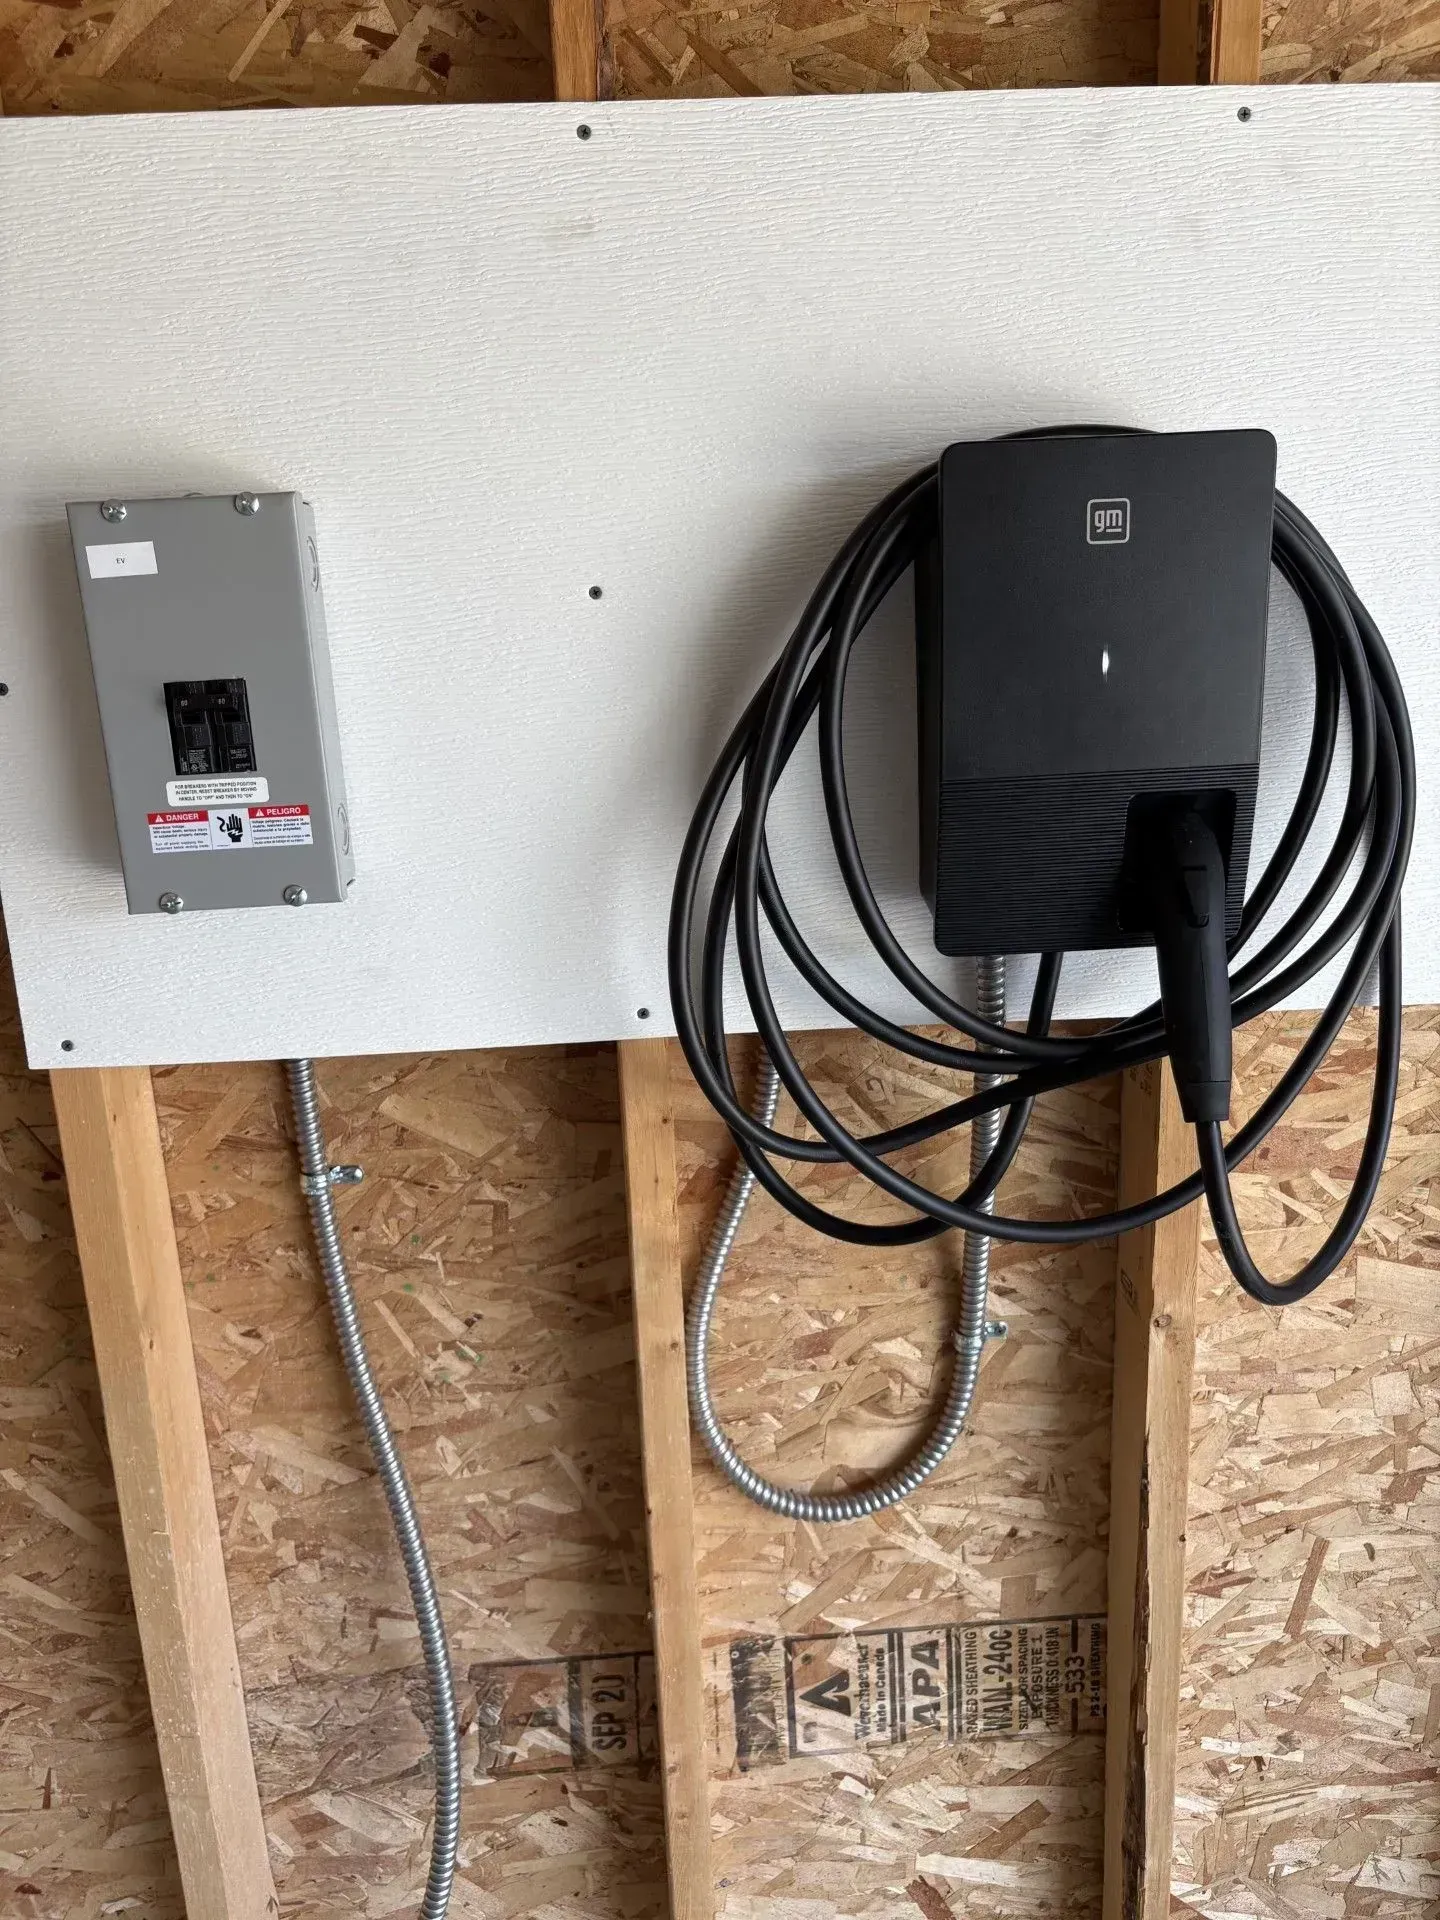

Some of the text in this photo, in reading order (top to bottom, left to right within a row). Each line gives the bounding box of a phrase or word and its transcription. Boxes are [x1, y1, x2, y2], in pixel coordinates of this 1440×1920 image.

[1094, 509, 1122, 533] gm
[166, 813, 199, 822] DANGER
[267, 807, 301, 816] PELIGRO
[875, 1647, 886, 1688] Canada
[1018, 1627, 1029, 1674] SPACING
[1089, 1622, 1101, 1677] SHEATHING
[911, 1638, 942, 1732] APA
[965, 1630, 979, 1734] RATED SHEATHING
[1031, 1648, 1044, 1720] EXPOSURE
[1064, 1655, 1086, 1694] 533
[1019, 1698, 1029, 1730] SIZED
[1045, 1668, 1060, 1727] THICKNESS
[1090, 1703, 1101, 1717] PS
[592, 1711, 627, 1750] SEP
[875, 1706, 887, 1733] Made
